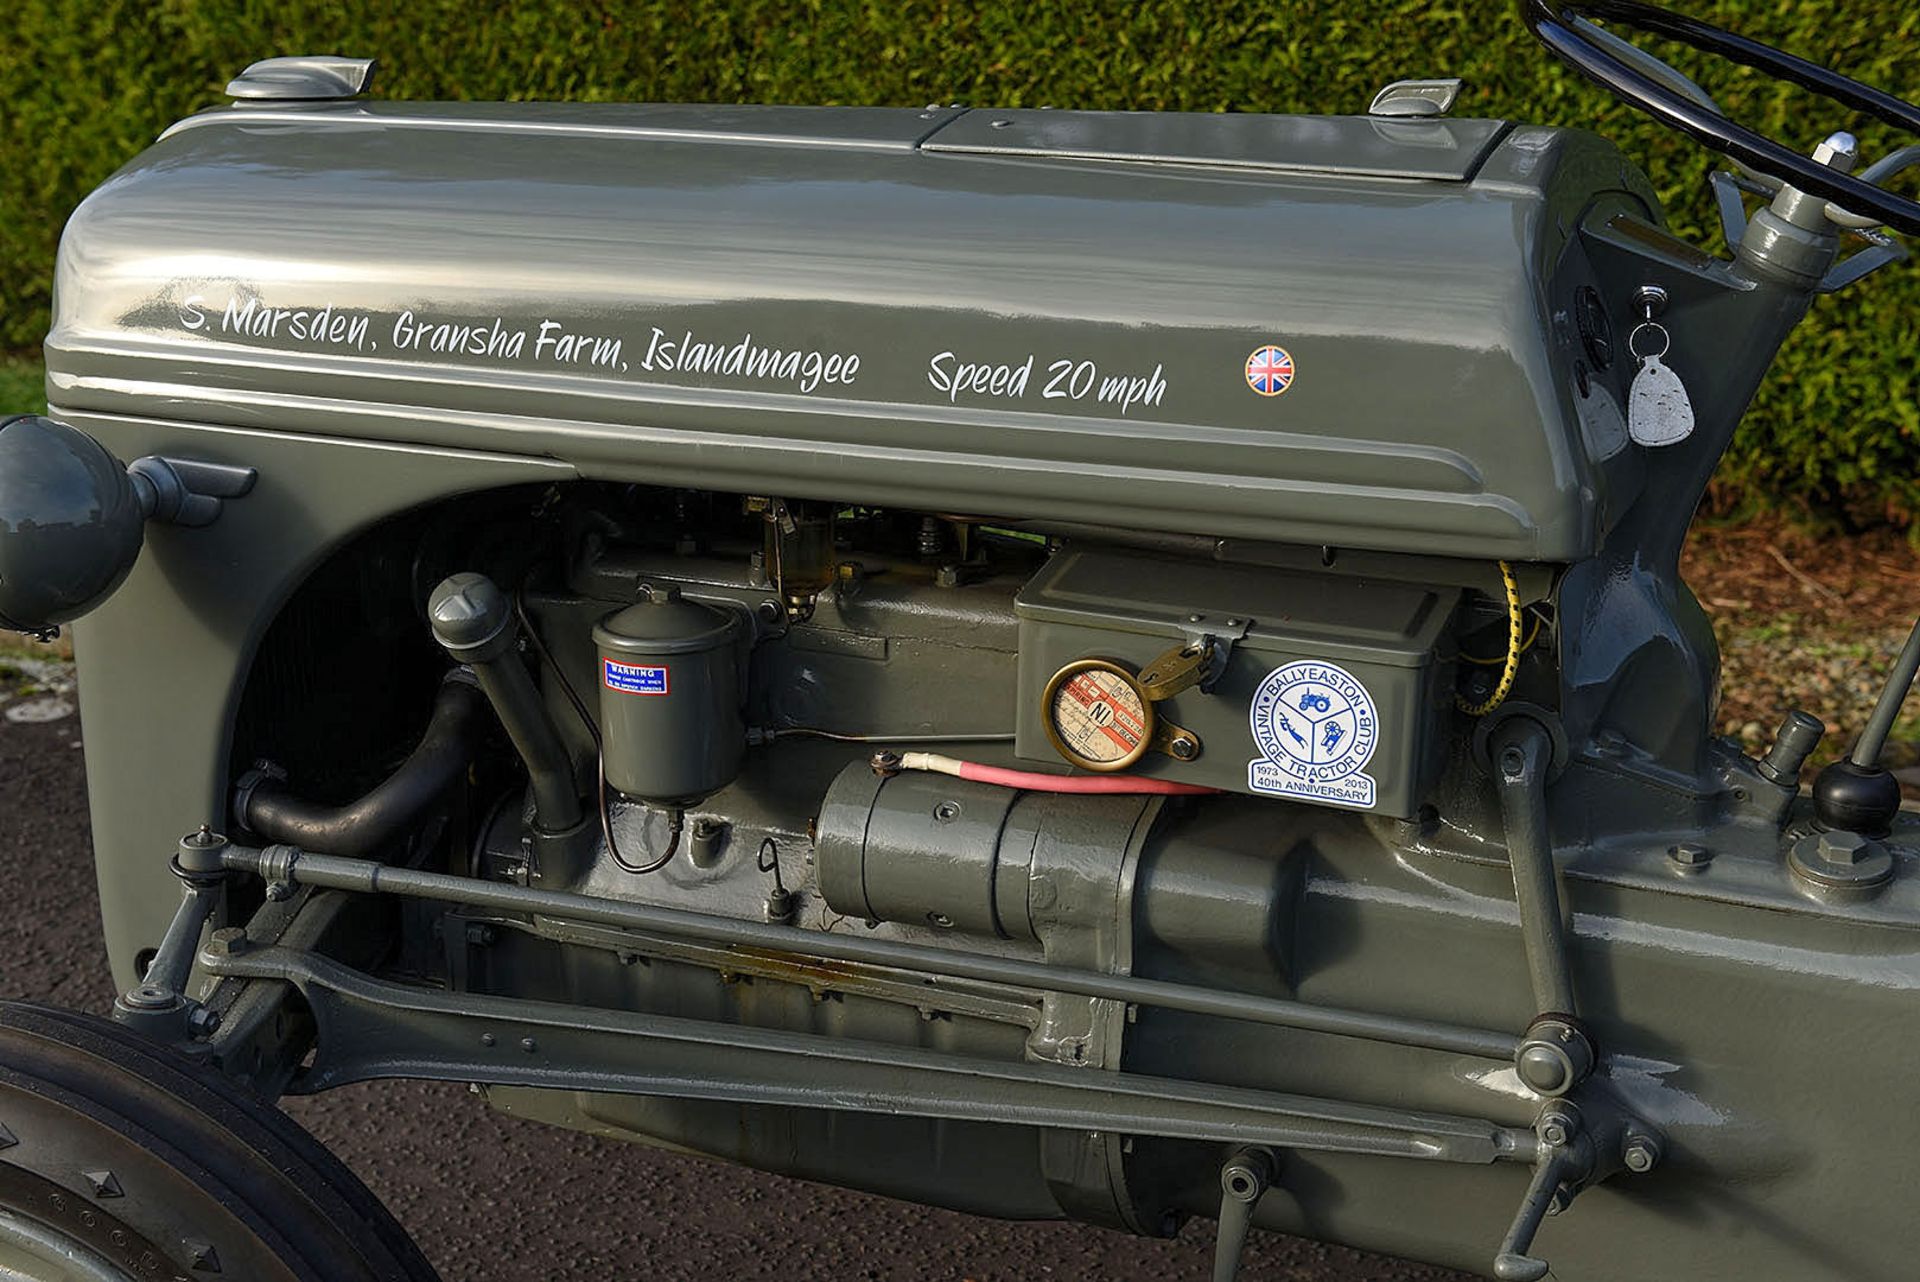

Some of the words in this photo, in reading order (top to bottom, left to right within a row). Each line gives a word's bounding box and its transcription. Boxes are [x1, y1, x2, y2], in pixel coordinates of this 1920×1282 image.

[180, 295, 211, 332] S.
[222, 298, 377, 351] Marsden,
[393, 311, 527, 359] Gransha
[535, 319, 629, 373] Farm,
[641, 326, 861, 393] Islandmagee
[927, 352, 1035, 402] Speed
[1042, 360, 1096, 400] 20
[1098, 363, 1168, 415] mph
[611, 665, 655, 677] WARNING
[1266, 668, 1364, 707] BALLYEASTON
[1258, 705, 1287, 763] VINTAGE
[1289, 756, 1358, 780] TRACTOR
[1354, 717, 1372, 756] CLUB
[1257, 766, 1279, 777] 1973
[1344, 779, 1368, 789] 2013
[1257, 777, 1282, 789] 40th
[1285, 781, 1368, 801] ANNIVERSARY
